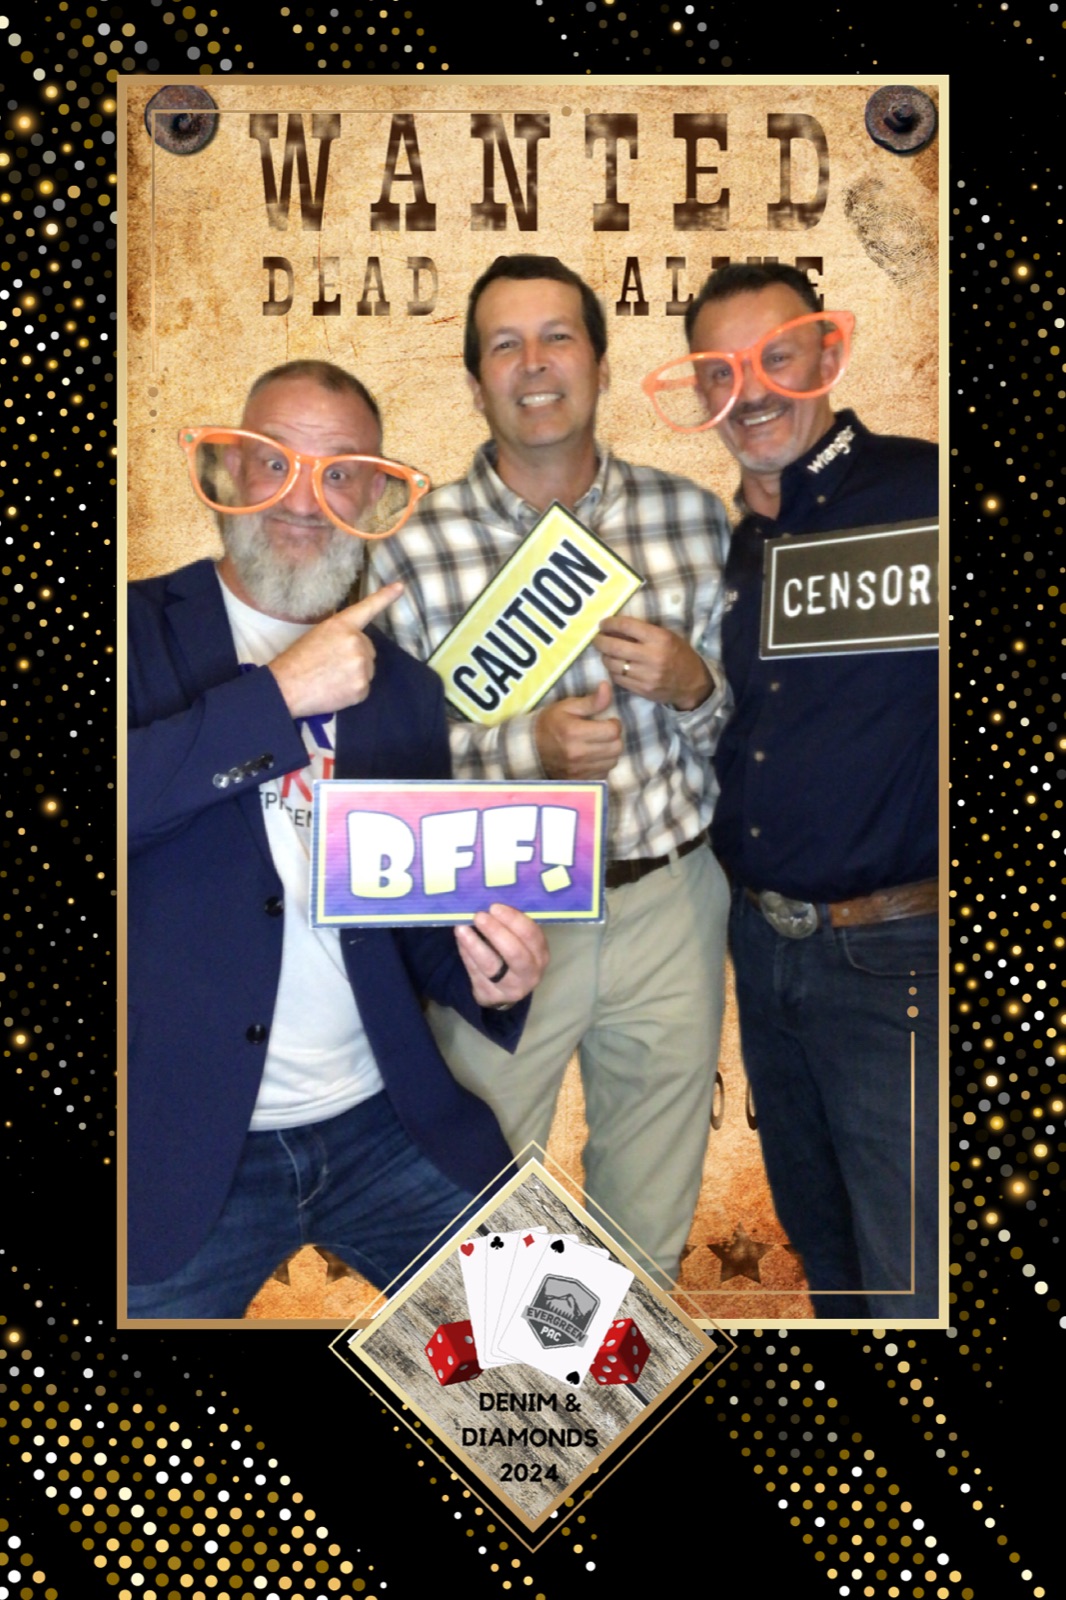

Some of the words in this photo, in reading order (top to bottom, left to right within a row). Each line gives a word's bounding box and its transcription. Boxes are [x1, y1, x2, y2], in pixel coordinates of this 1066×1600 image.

[250, 113, 830, 231] WANTED
[262, 256, 439, 316] DEAD
[452, 539, 608, 711] CAUTION
[783, 564, 938, 617] CENSOR
[346, 804, 577, 898] BFF!
